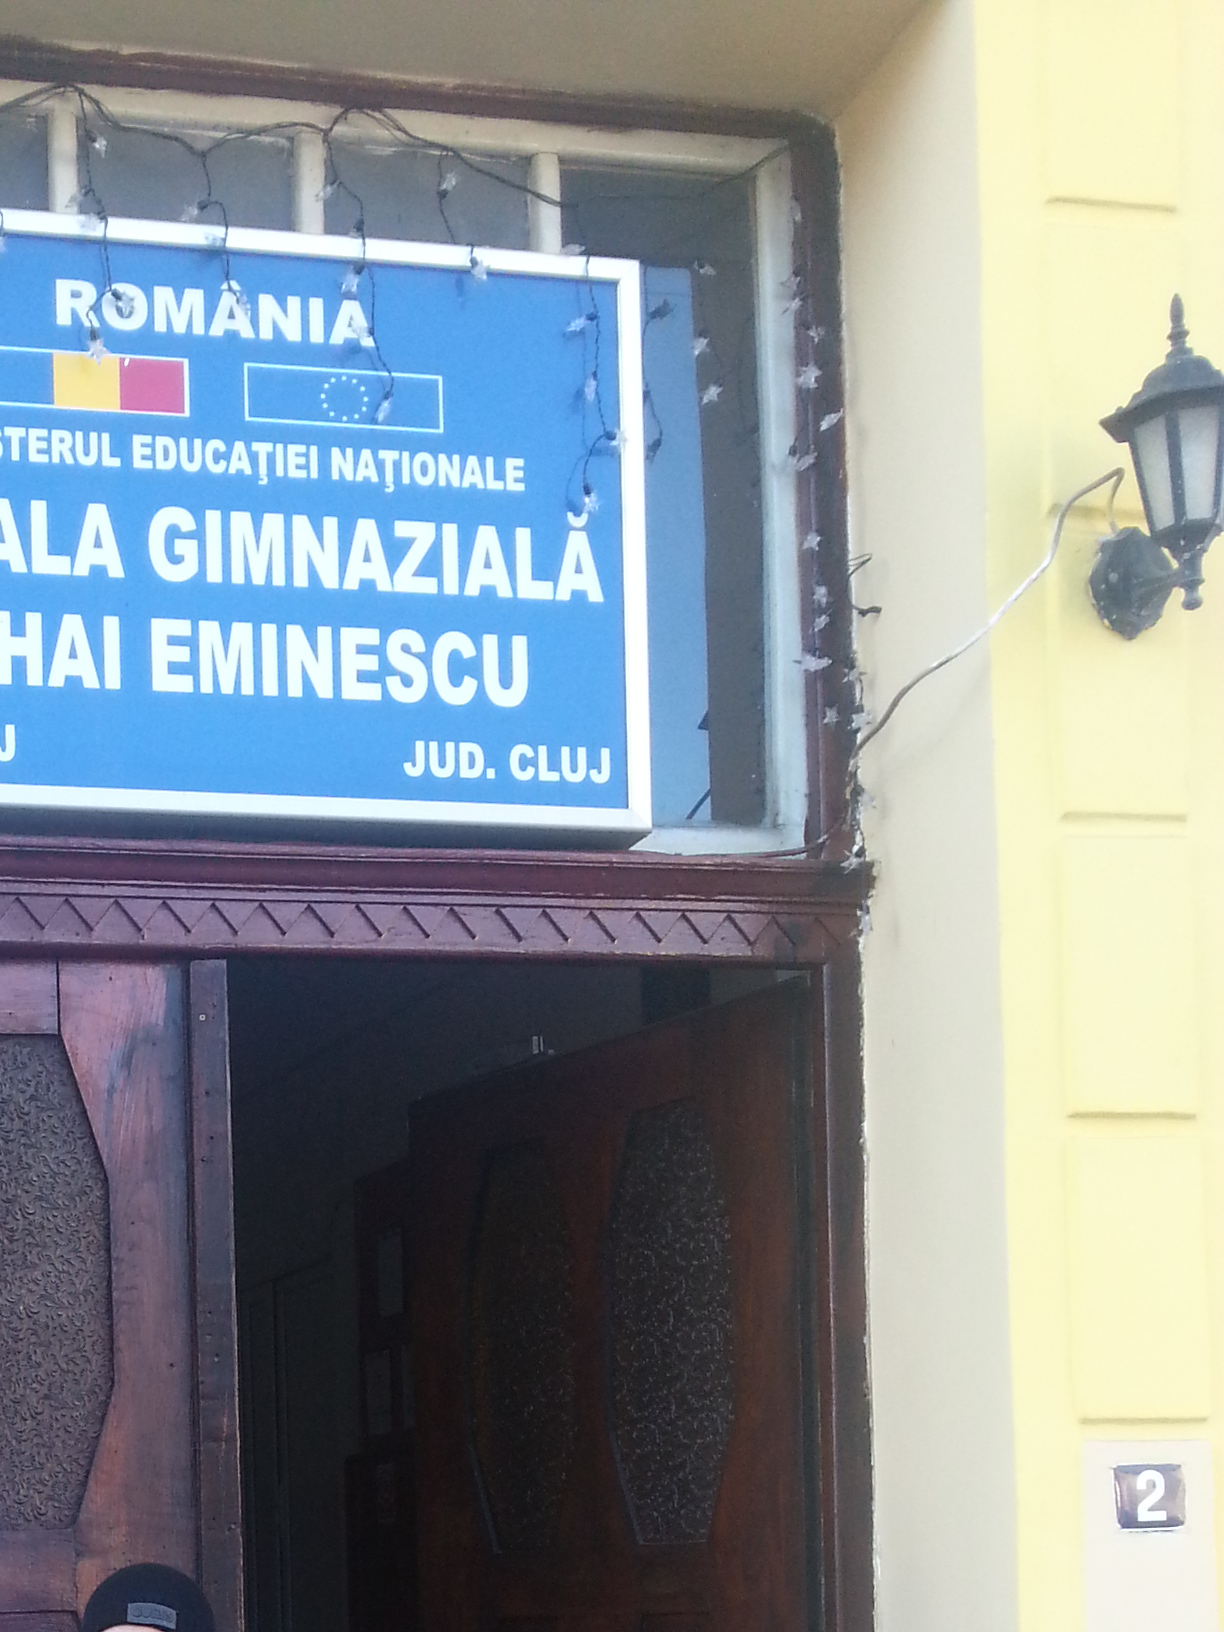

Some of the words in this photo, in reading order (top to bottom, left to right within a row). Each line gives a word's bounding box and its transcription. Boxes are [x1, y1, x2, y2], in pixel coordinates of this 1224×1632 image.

[54, 278, 375, 347] ROMÂNIA
[131, 433, 319, 486] EDUCAŢIEI
[330, 446, 526, 493] NAŢIONALE
[147, 506, 605, 603] GIMNAZIALĂ
[150, 617, 530, 708] EMINESCU
[403, 740, 497, 780] JUD.
[509, 743, 612, 784] CLUJ
[1136, 1469, 1168, 1522] 2
